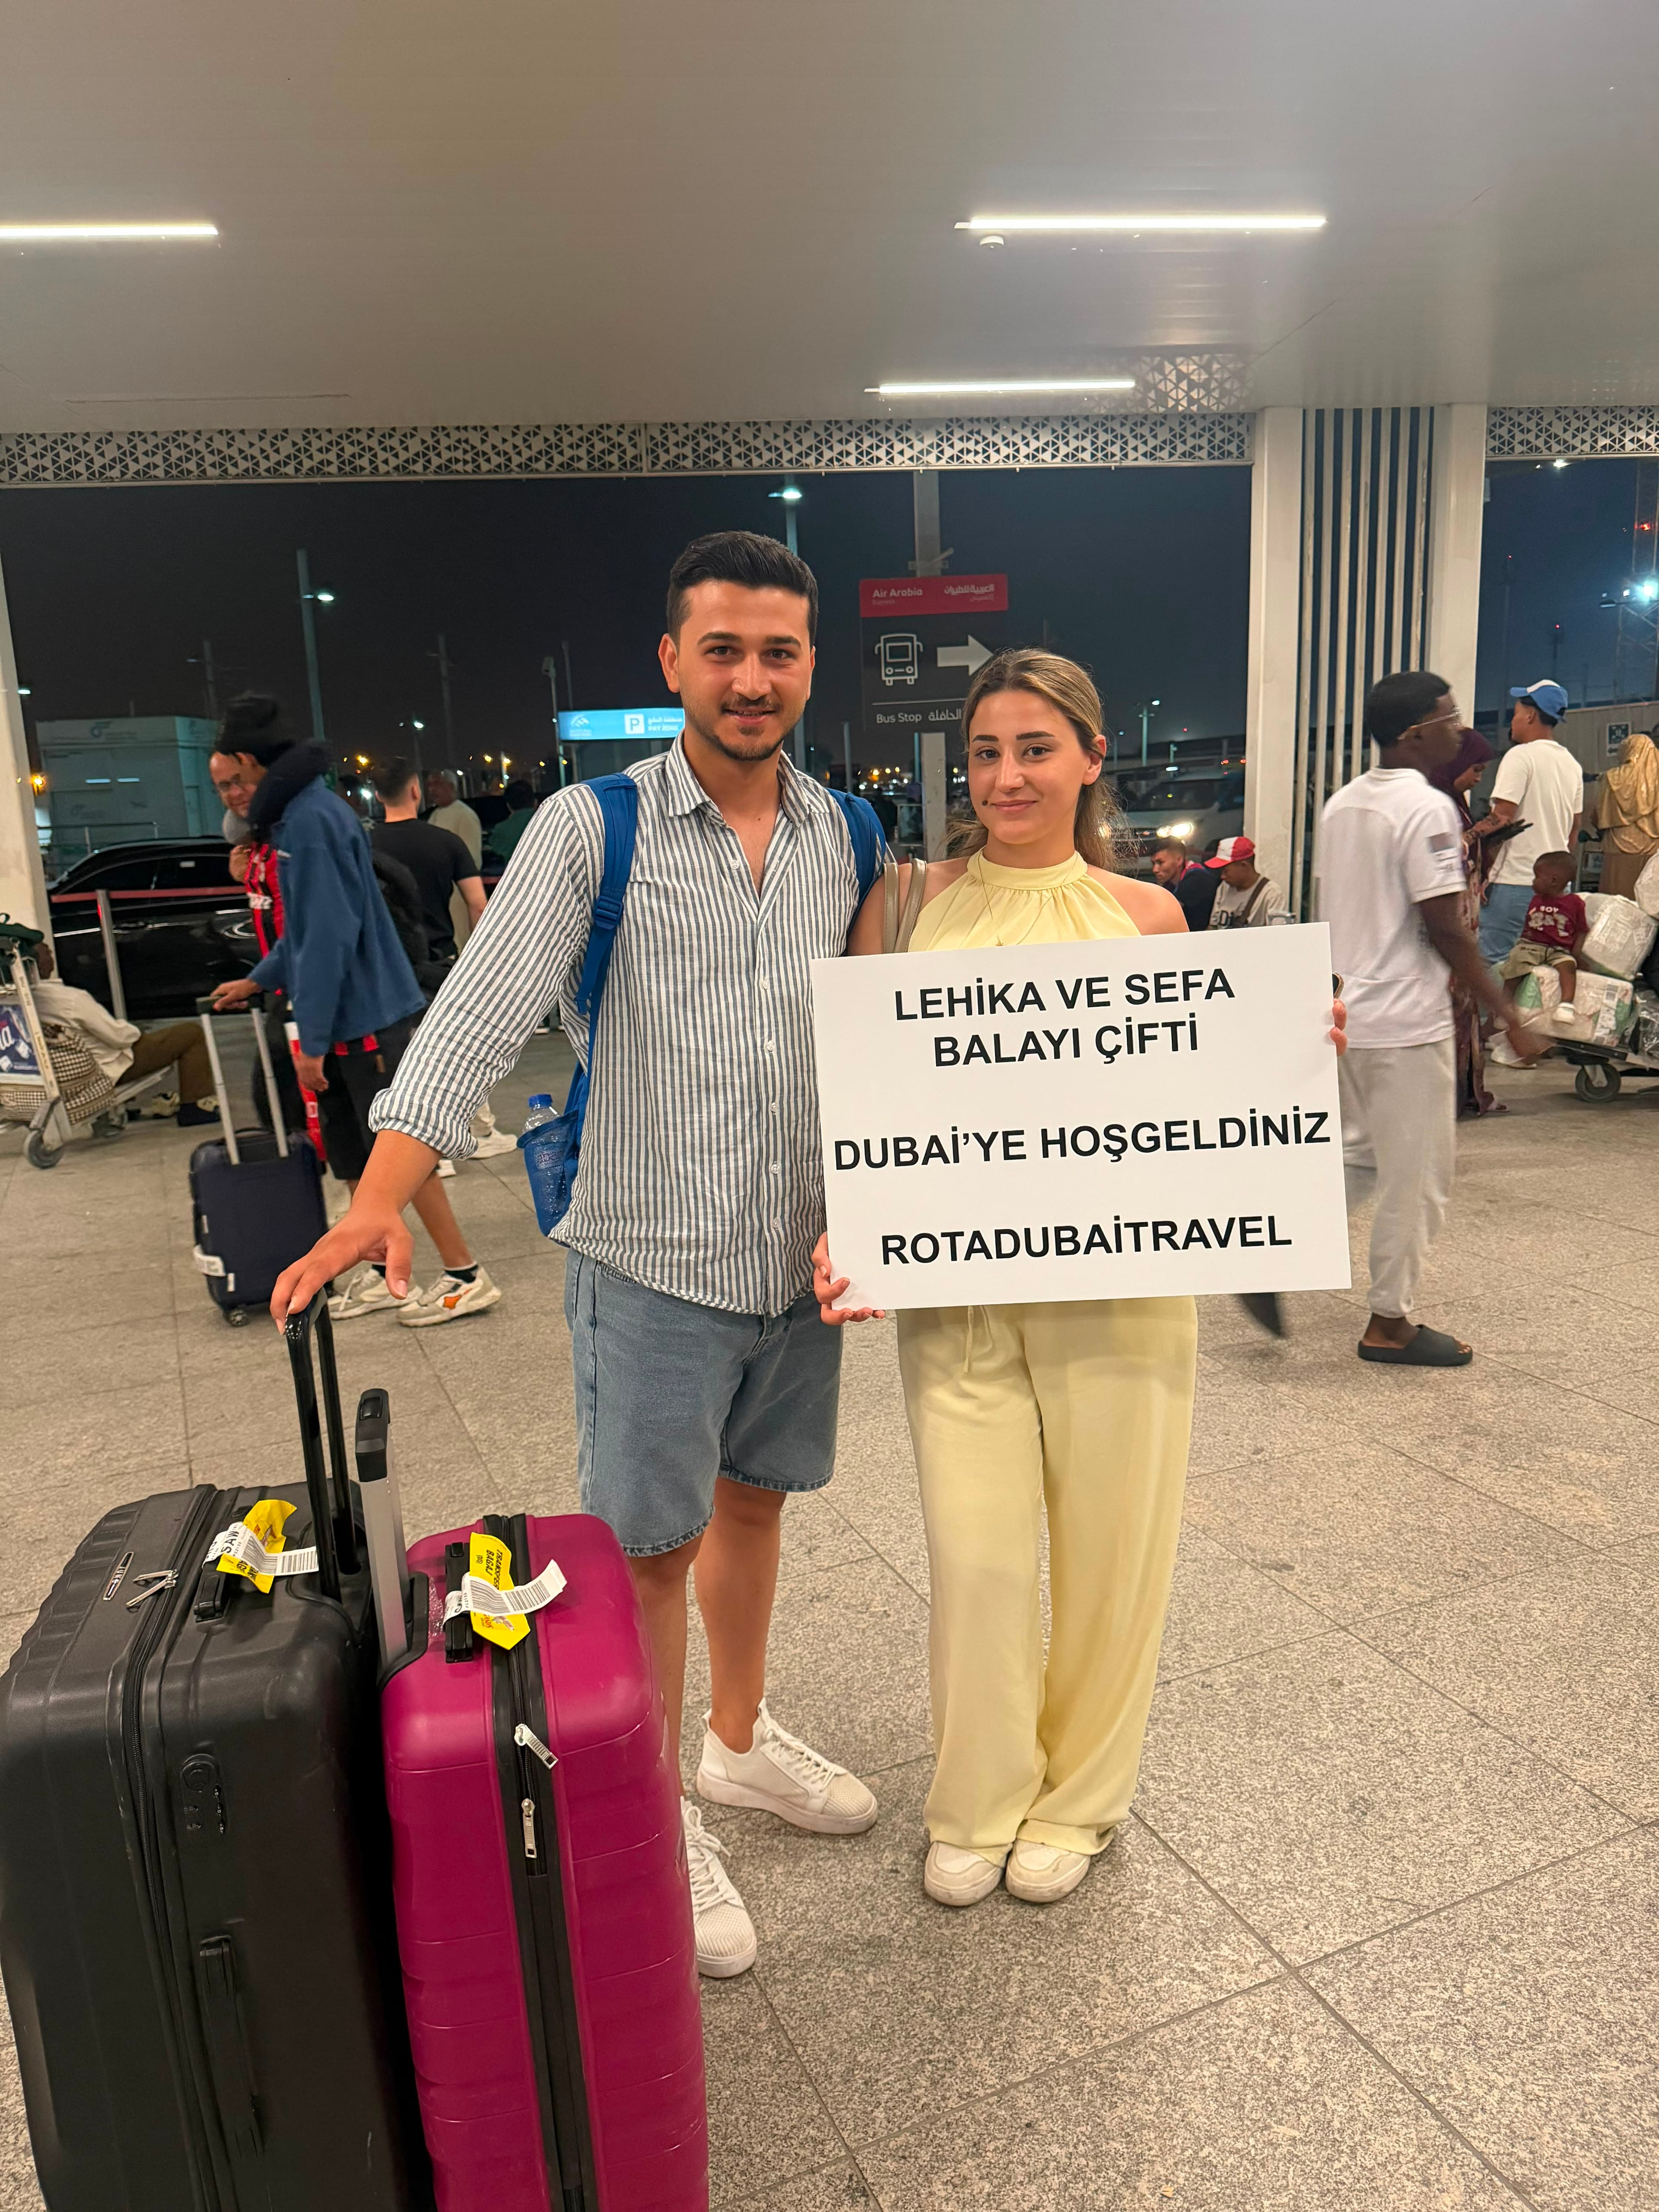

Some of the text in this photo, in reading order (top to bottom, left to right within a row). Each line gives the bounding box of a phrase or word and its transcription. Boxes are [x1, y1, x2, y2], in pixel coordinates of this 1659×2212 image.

[873, 587, 923, 597] Air Arabia
[876, 712, 922, 724] Bus Stop
[928, 708, 962, 721] الحافلة
[895, 968, 1235, 1020] LEHİKA VE SEFA
[934, 1012, 1198, 1067] BALAYI ÇİFTİ
[1041, 1106, 1330, 1163] HOŞGELDİNİZ
[882, 1215, 1292, 1265] ROTADUBAİTRAVEL
[220, 1531, 239, 1554] SAW
[485, 1549, 494, 1576] BAGAJ
[493, 1549, 503, 1590] TRANSFER
